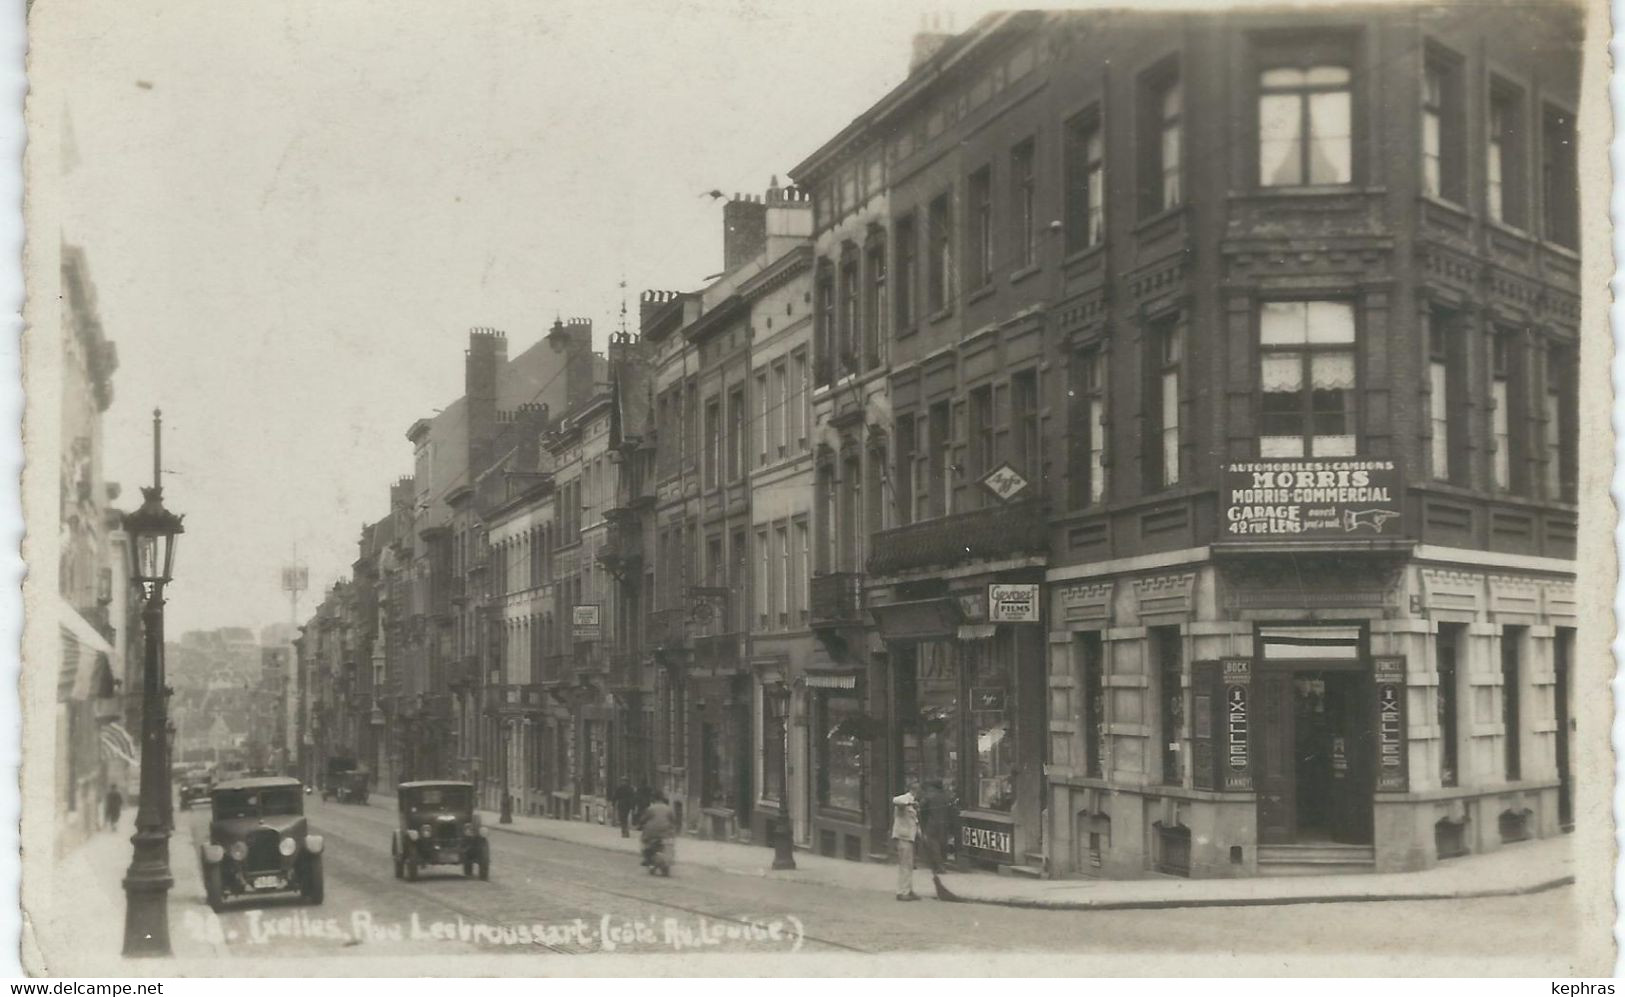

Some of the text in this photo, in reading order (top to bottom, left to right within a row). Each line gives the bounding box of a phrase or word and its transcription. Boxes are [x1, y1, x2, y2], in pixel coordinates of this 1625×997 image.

[1229, 462, 1324, 472] AUTOMOBILES
[1332, 461, 1394, 471] CAMIONS
[1252, 471, 1370, 489] MORRIS
[1232, 487, 1392, 503] MORRIS-COMMERCIAL
[1227, 505, 1301, 521] GARAGE
[1249, 522, 1268, 534] rue
[1001, 604, 1031, 613] FILMS
[1229, 690, 1247, 766] IXELLES
[1381, 690, 1400, 766] IXELLES
[962, 826, 1010, 853] GEVAERT
